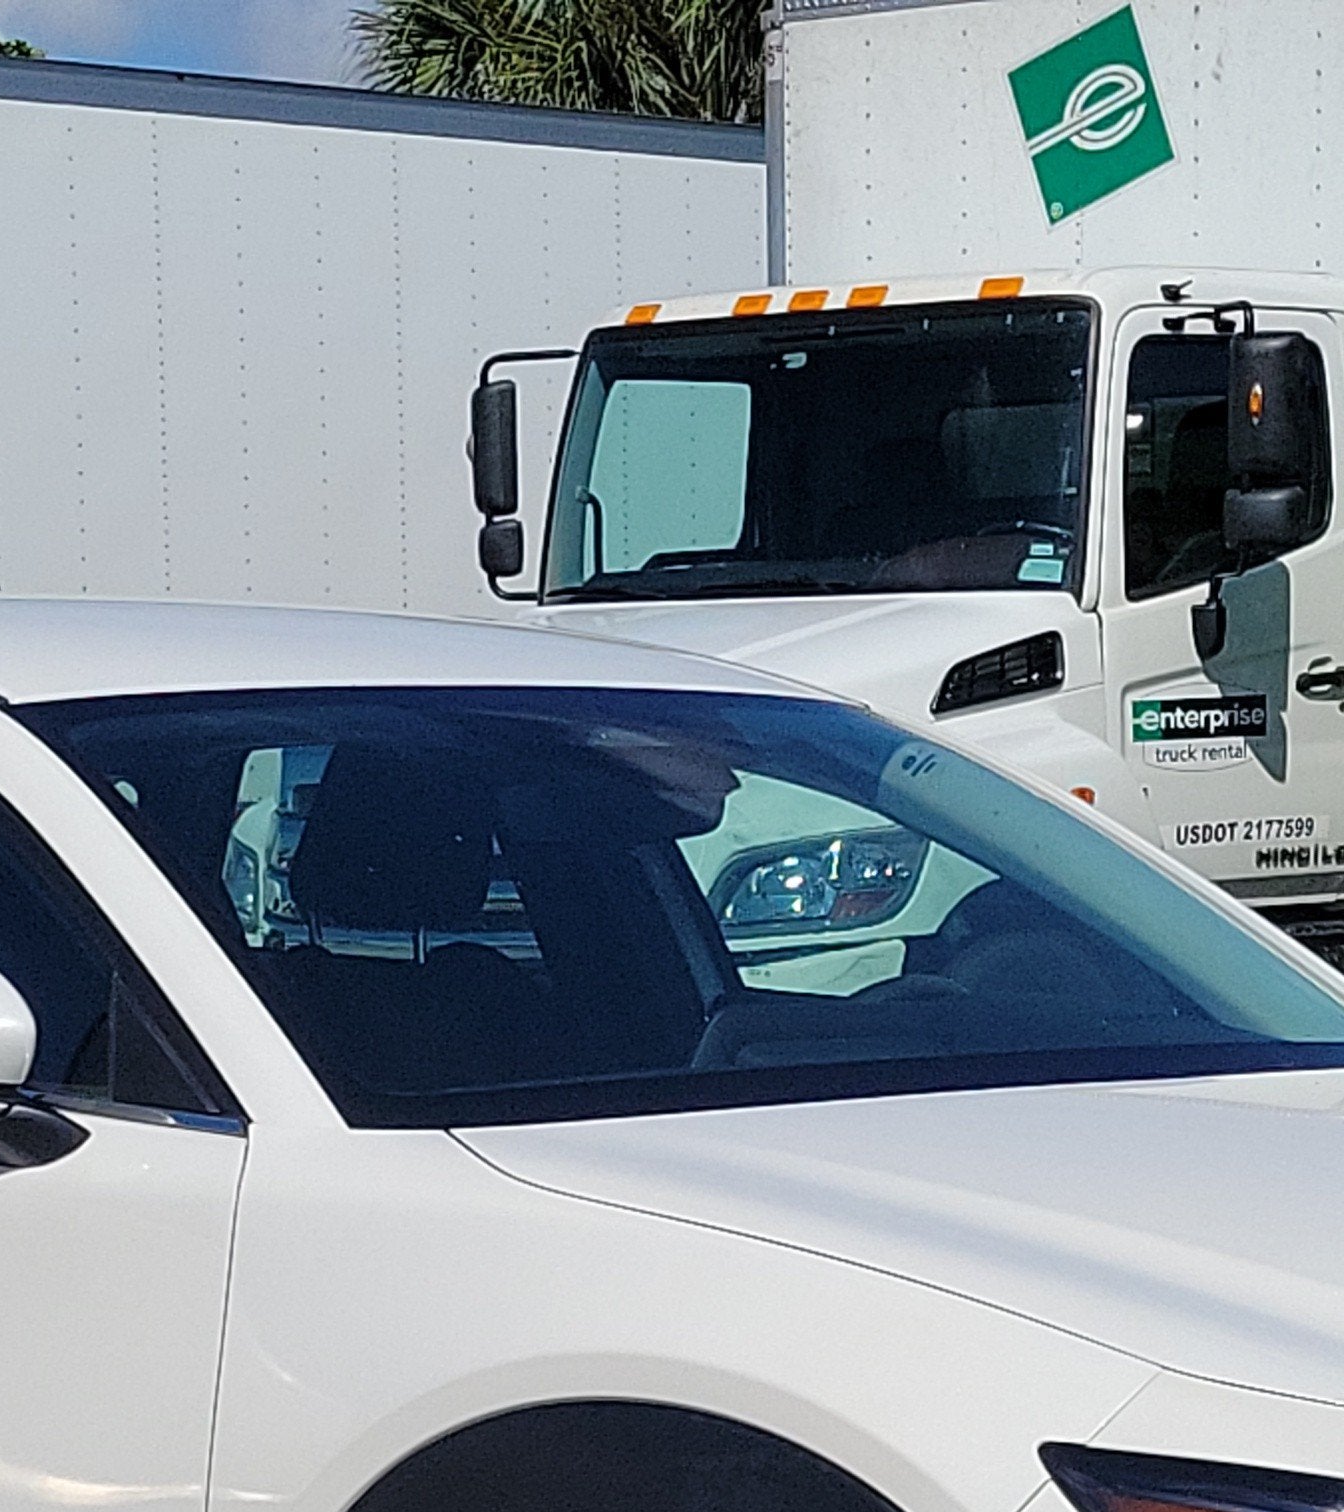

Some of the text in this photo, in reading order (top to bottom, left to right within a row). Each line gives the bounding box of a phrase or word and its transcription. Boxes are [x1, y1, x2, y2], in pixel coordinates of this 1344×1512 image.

[1133, 703, 1265, 734] enterprise
[1156, 742, 1247, 763] truck rental
[1176, 816, 1315, 846] USDOT 2177599
